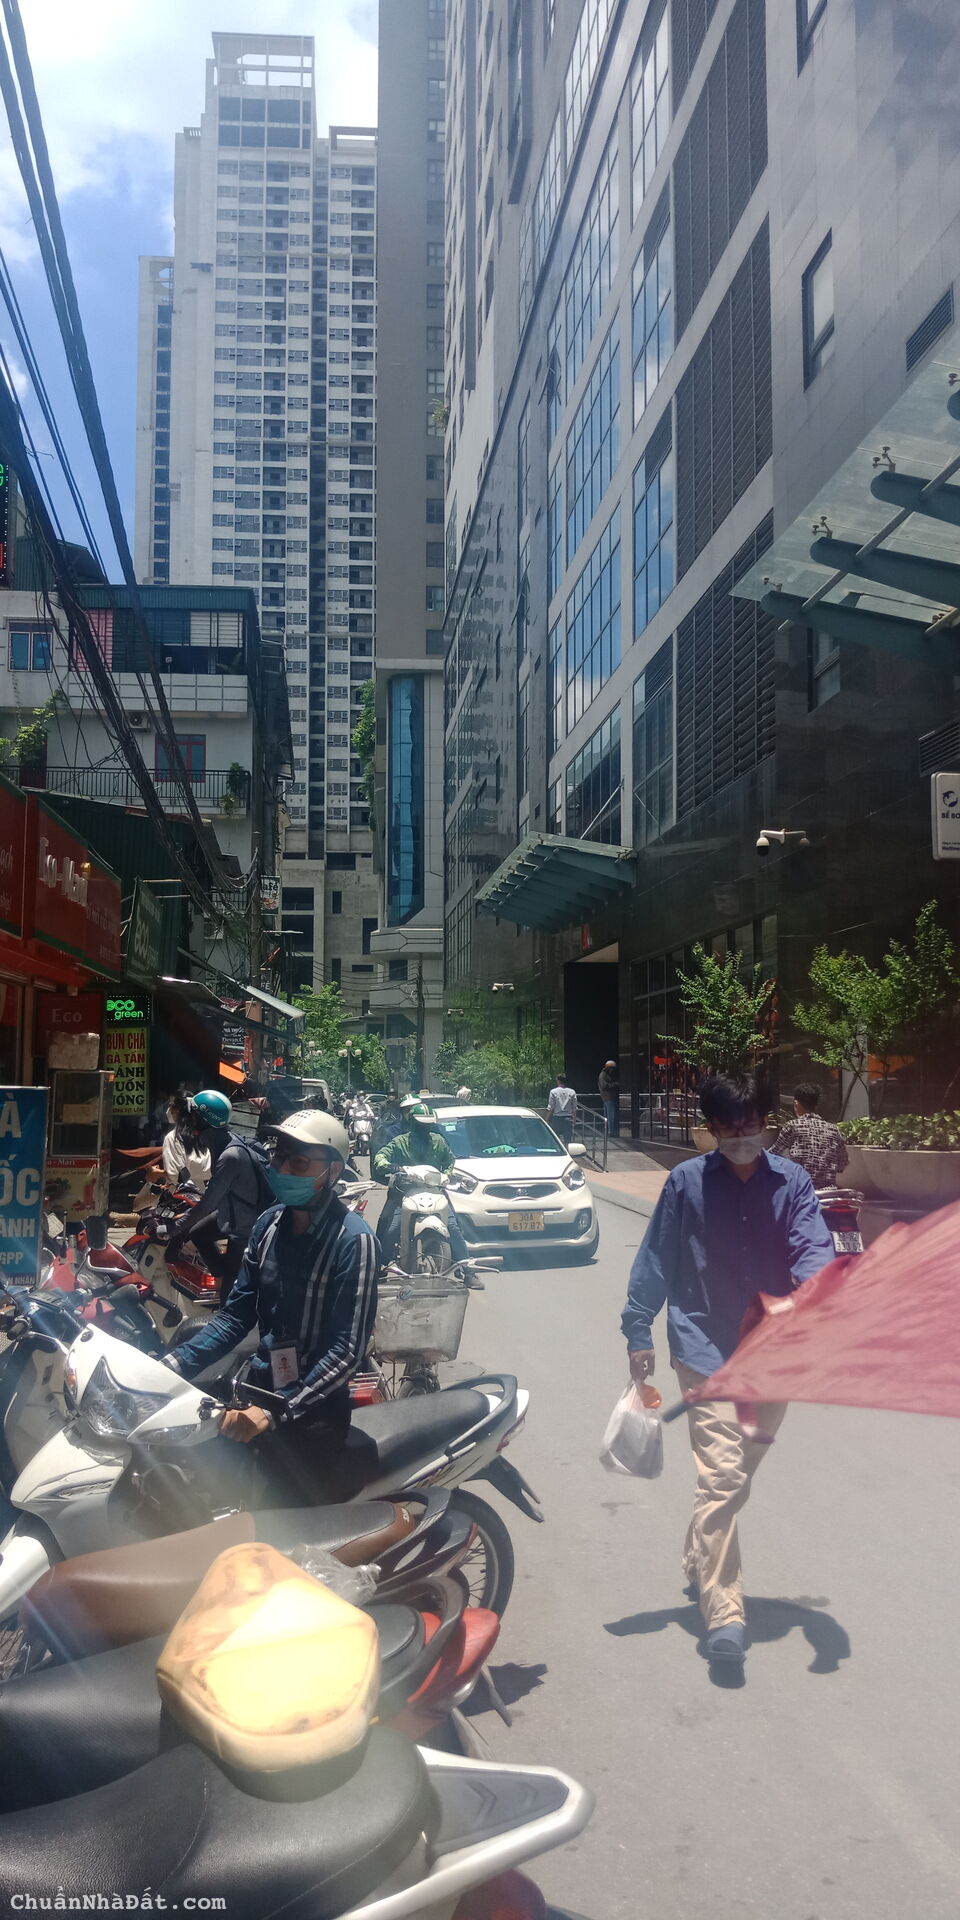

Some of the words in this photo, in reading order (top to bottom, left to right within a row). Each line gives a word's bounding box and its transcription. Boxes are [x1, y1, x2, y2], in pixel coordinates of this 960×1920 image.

[52, 1008, 82, 1024] Eco
[114, 1010, 144, 1021] green
[112, 1064, 145, 1078] ÁNH
[114, 1077, 145, 1092] UỐN
